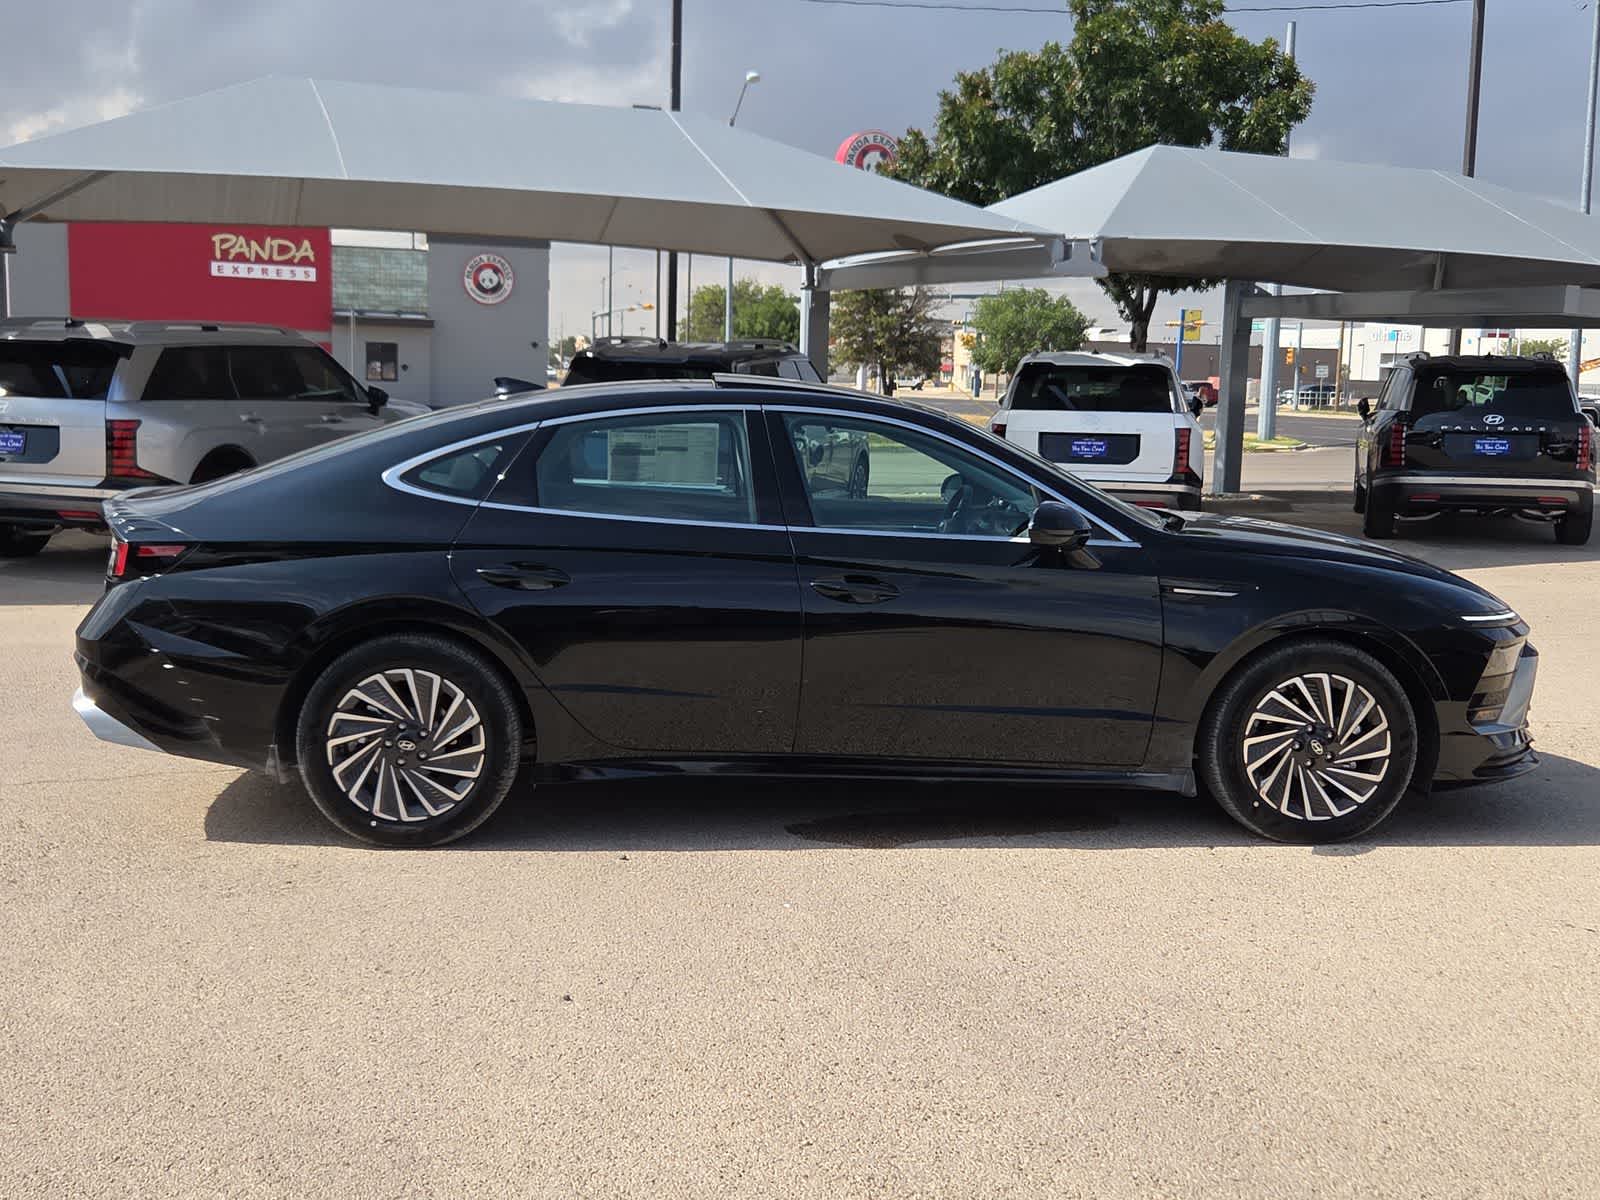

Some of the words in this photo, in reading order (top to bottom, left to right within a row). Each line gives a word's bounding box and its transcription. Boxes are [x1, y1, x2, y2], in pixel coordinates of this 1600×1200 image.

[872, 134, 898, 157] EXPR
[211, 233, 315, 263] PANDA
[216, 265, 311, 279] EXPRESS
